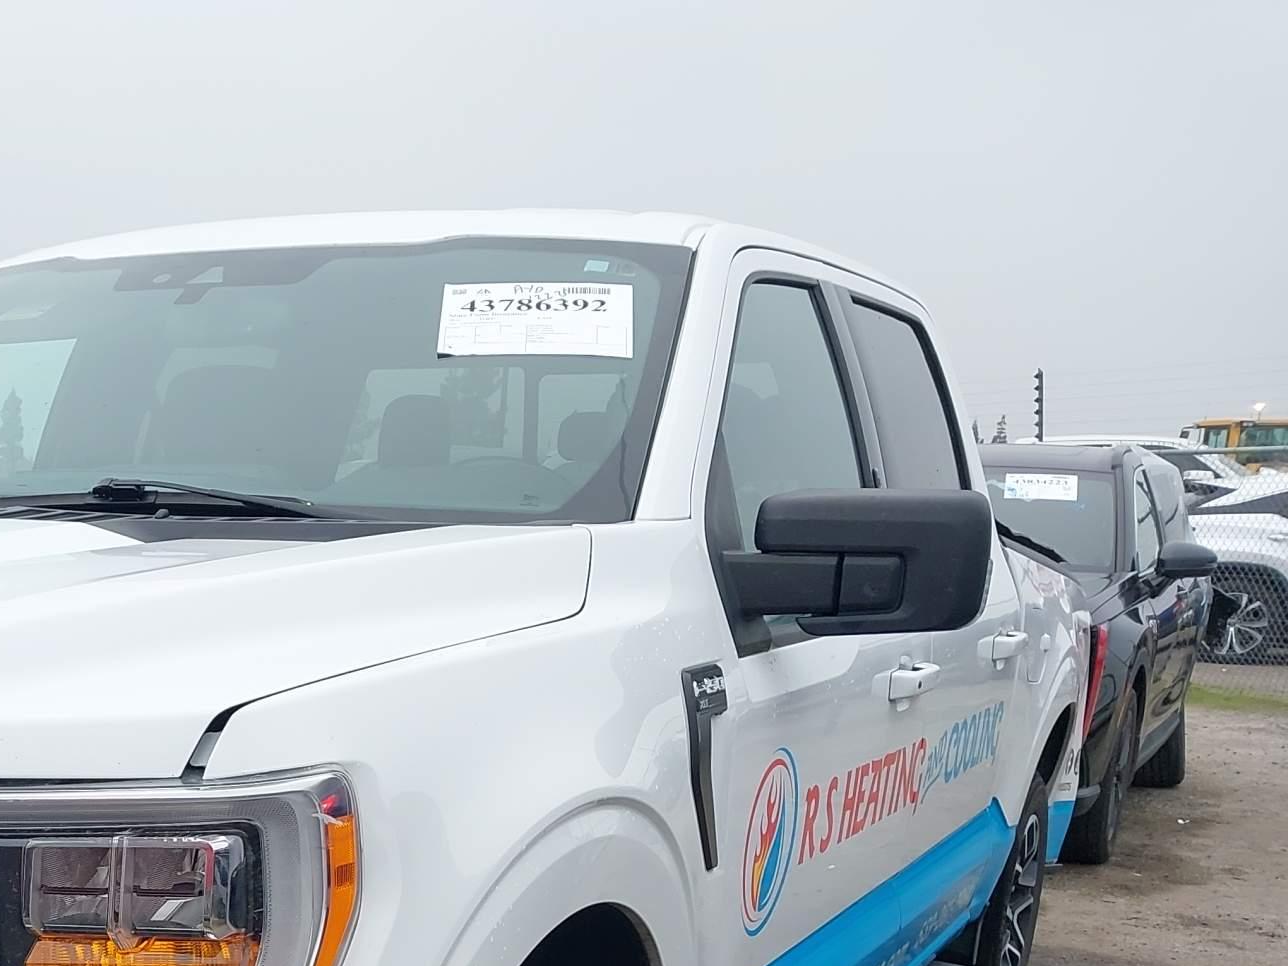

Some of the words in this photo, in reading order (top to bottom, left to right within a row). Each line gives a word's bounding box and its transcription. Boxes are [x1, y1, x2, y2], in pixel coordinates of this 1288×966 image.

[460, 298, 607, 313] 43786392
[797, 784, 821, 866] R
[819, 775, 840, 854] S
[836, 736, 928, 845] HEATING
[943, 700, 1004, 785] COOLING
